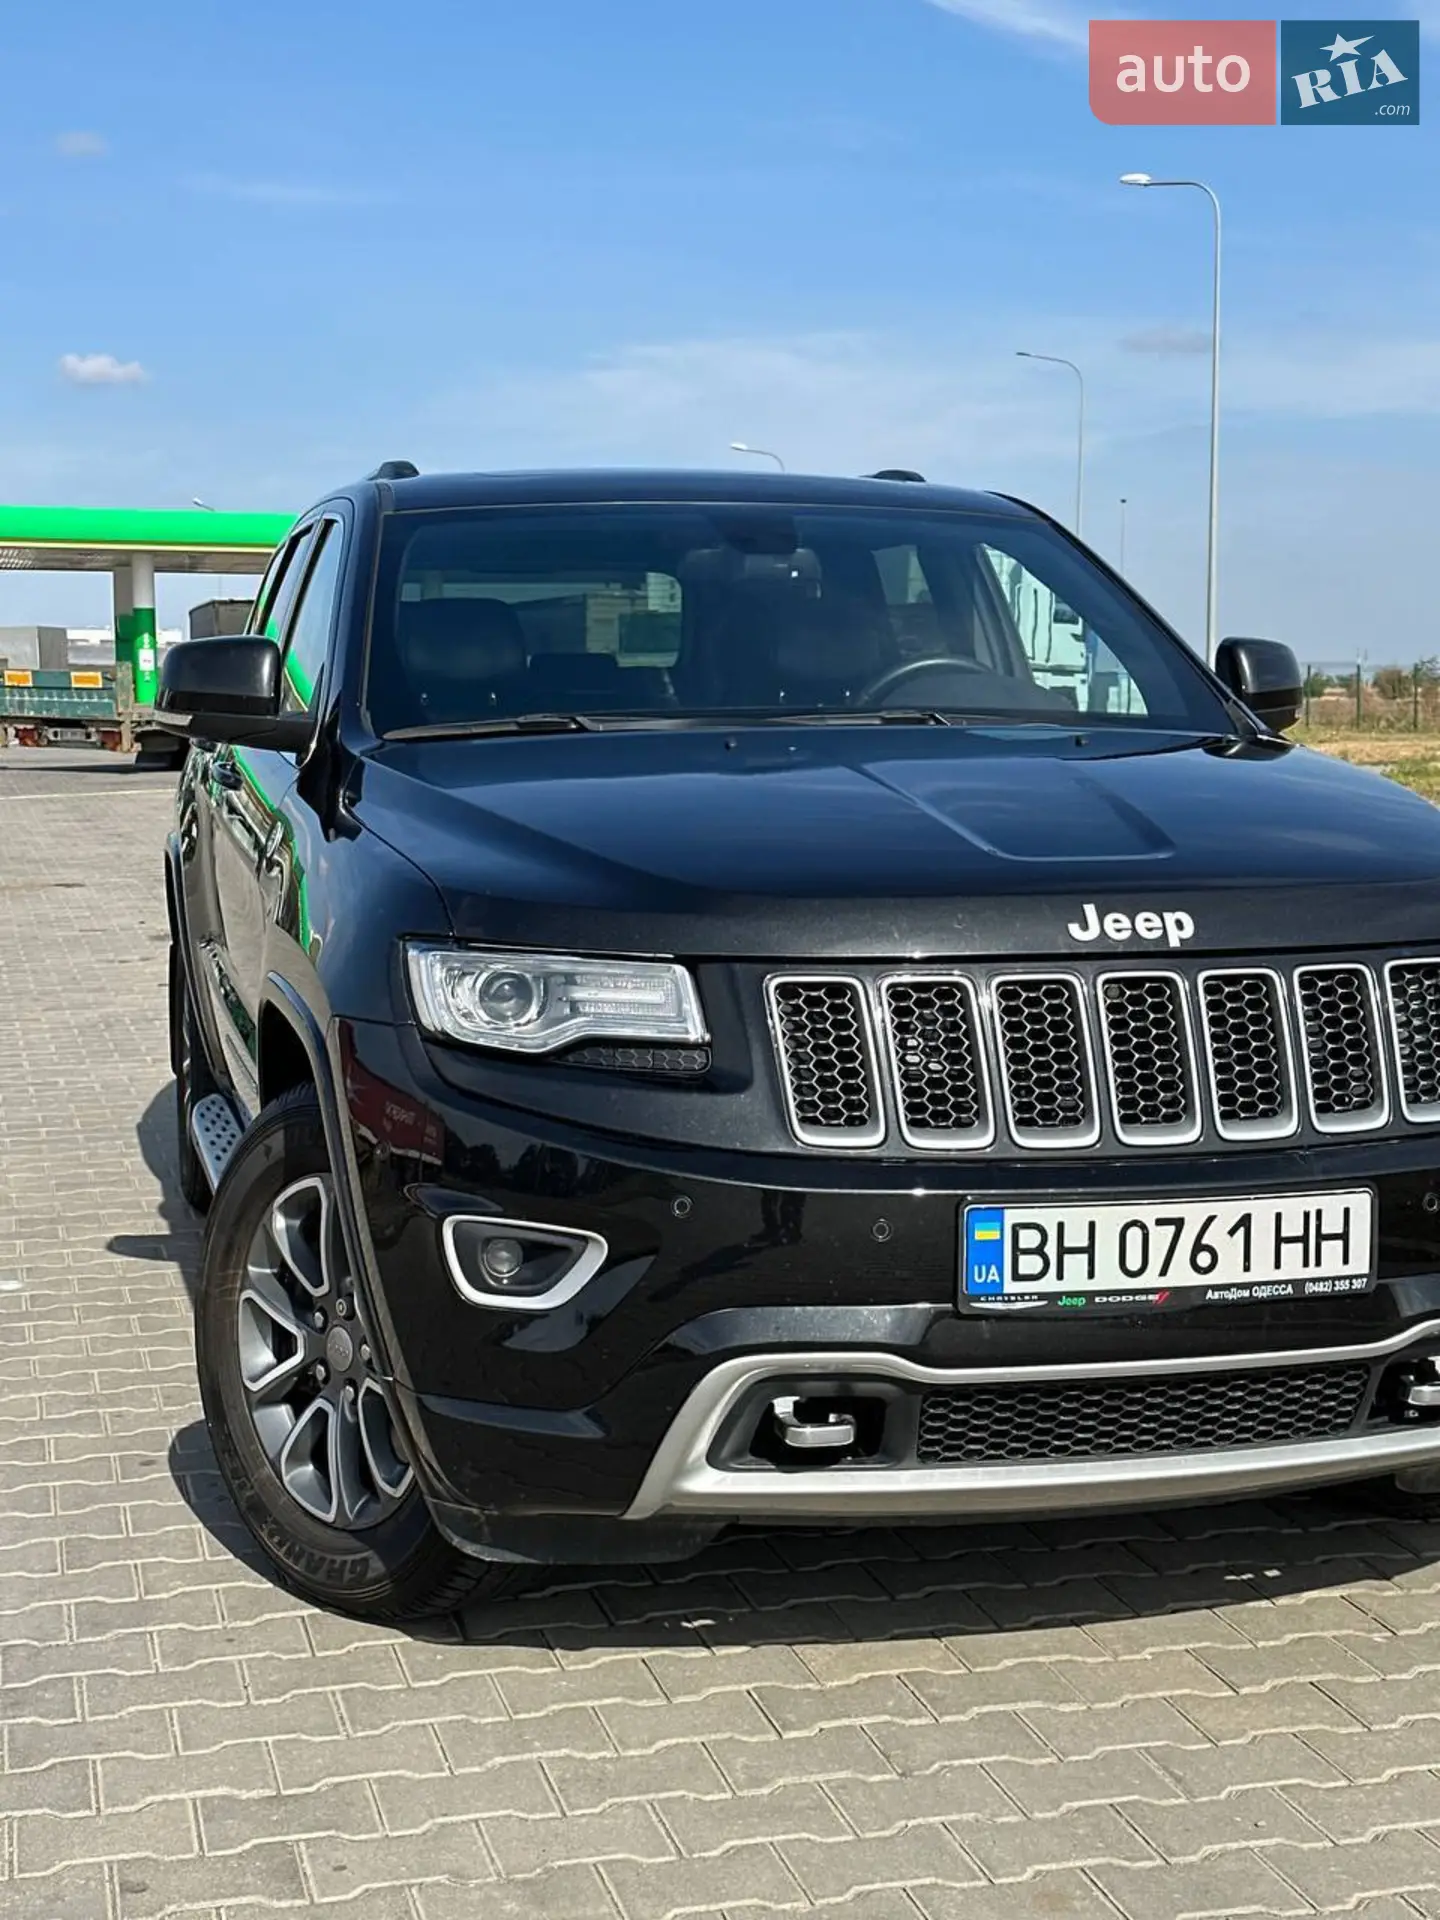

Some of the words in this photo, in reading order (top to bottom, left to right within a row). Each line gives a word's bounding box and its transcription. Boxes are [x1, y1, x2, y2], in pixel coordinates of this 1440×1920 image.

[1067, 903, 1195, 948] Jeep
[1010, 1220, 1096, 1282] BH
[1118, 1212, 1252, 1279] 0761
[1274, 1206, 1351, 1270] HH
[973, 1264, 1000, 1284] UA
[1057, 1295, 1087, 1307] Jeep
[1094, 1293, 1160, 1304] DODGE
